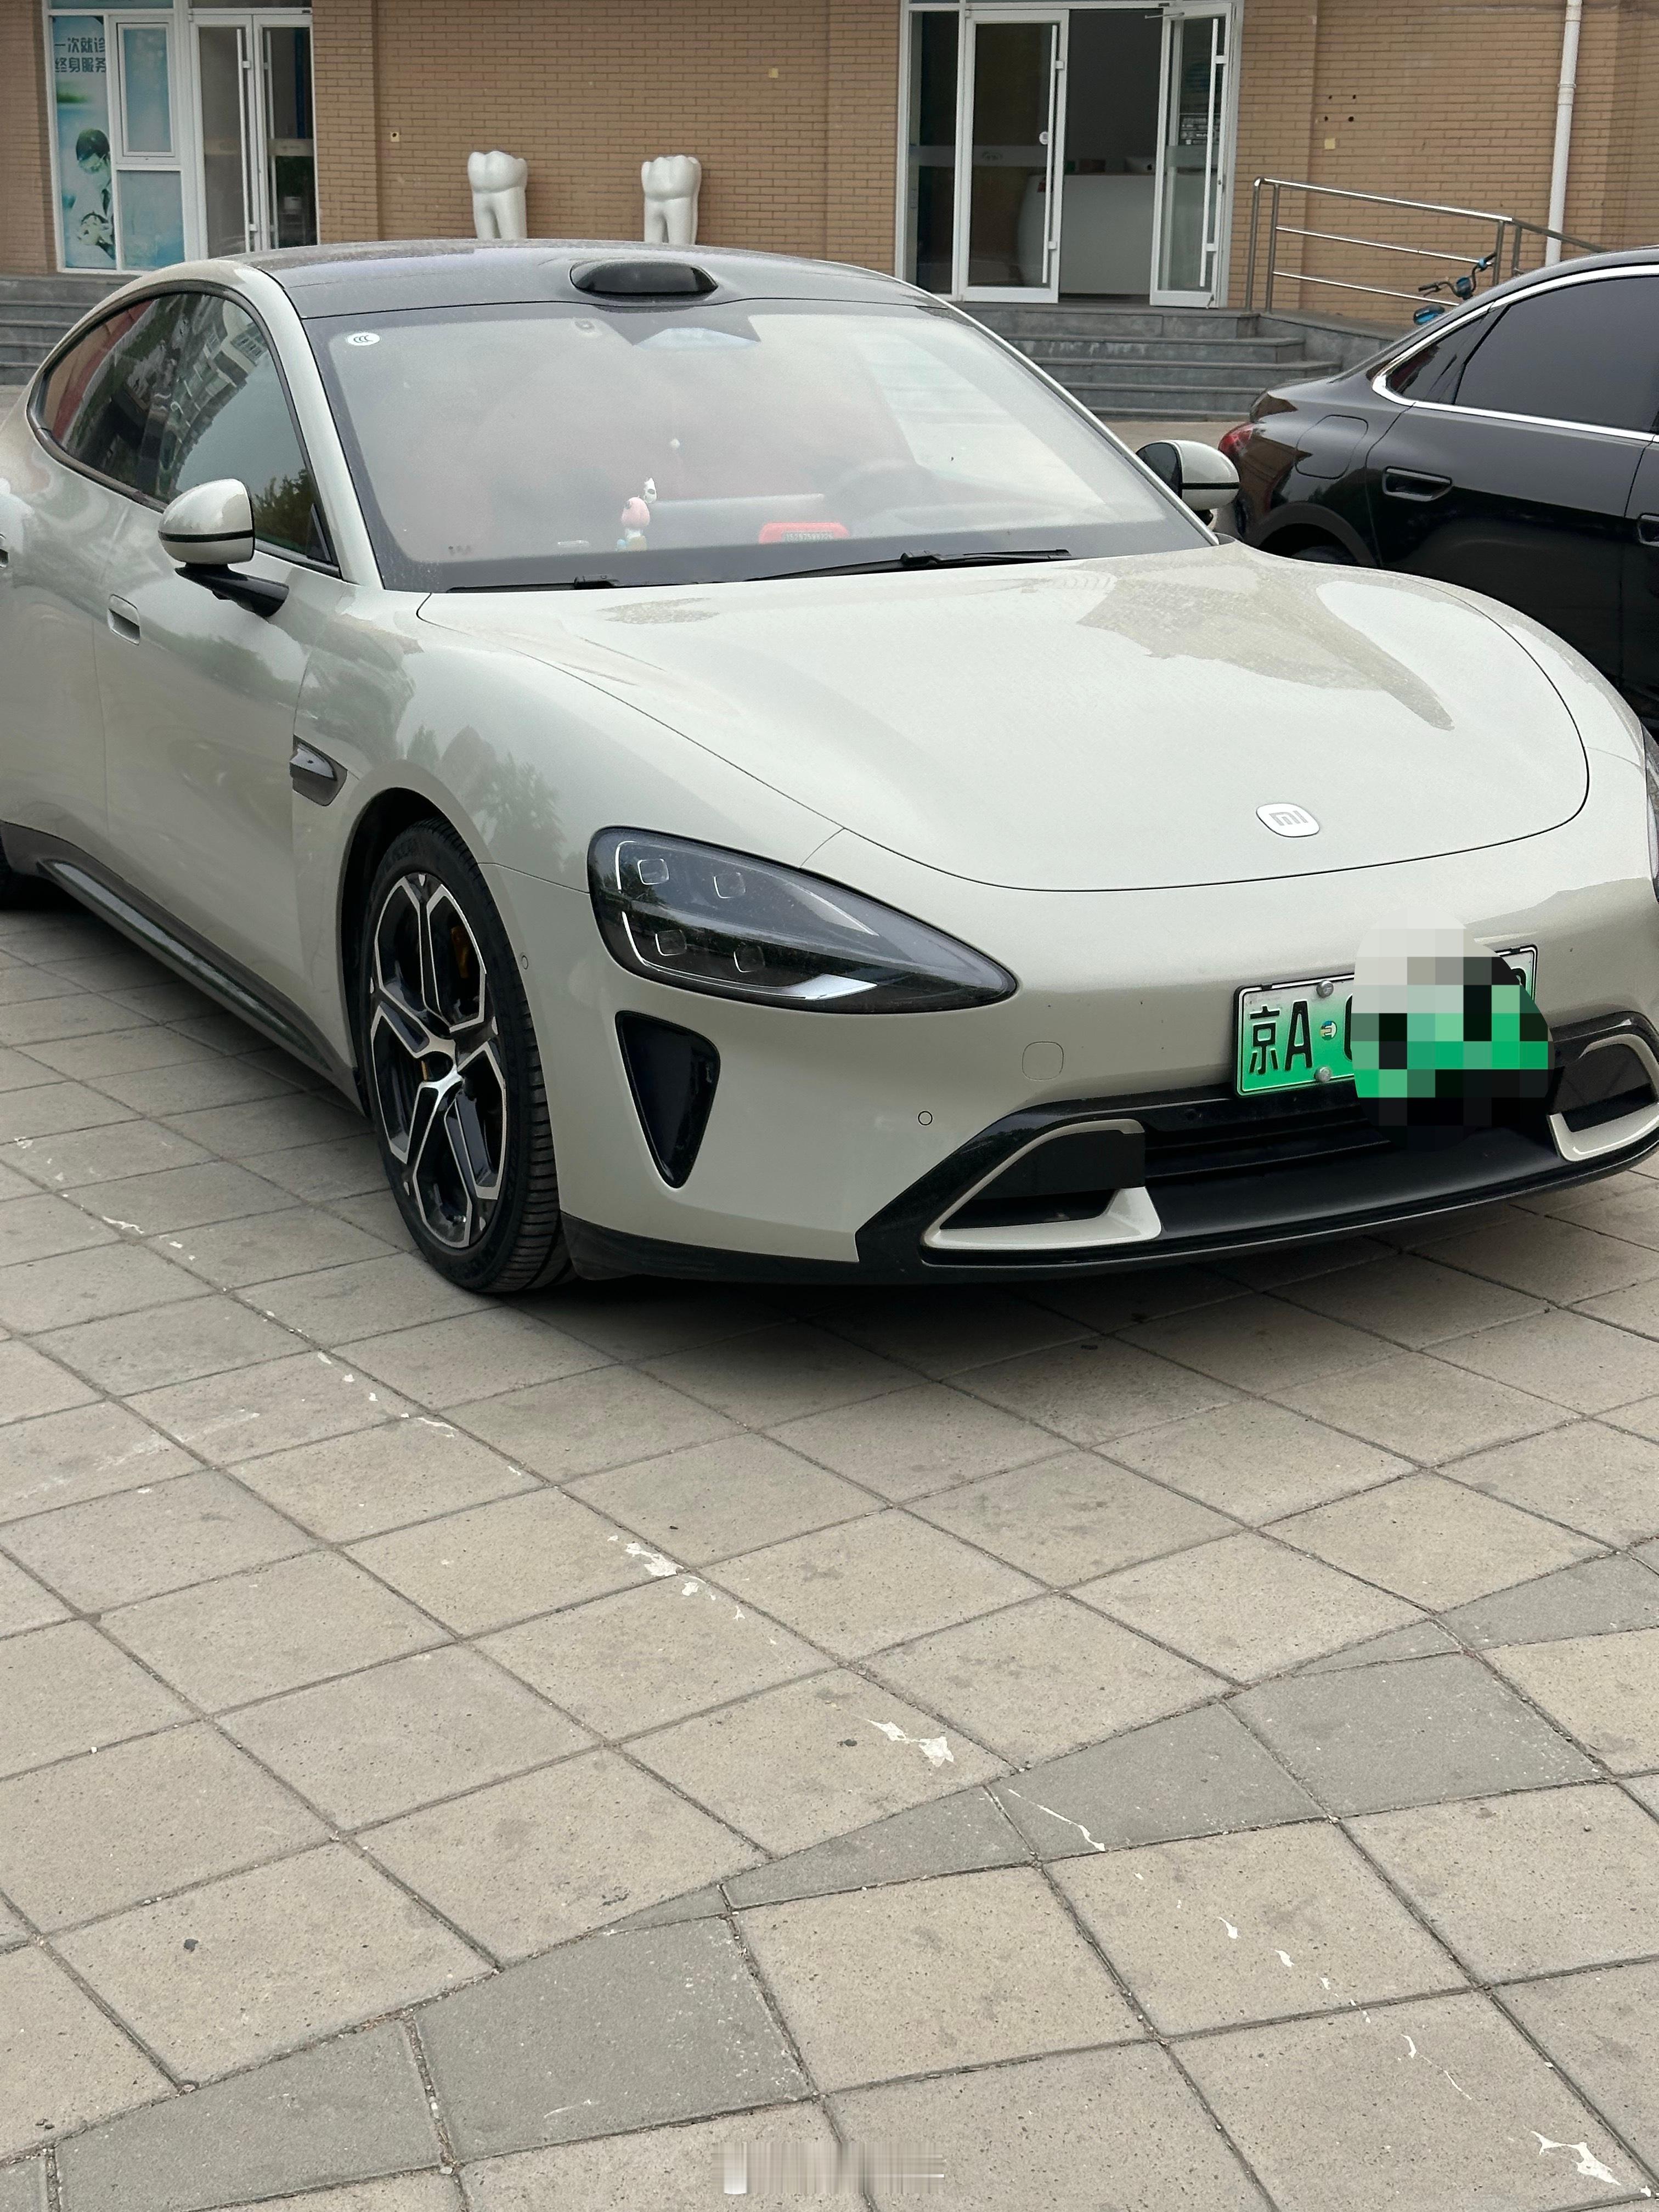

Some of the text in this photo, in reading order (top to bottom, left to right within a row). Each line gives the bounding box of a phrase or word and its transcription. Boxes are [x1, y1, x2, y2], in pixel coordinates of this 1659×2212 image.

[54, 37, 105, 53] 一次就诊
[55, 57, 106, 72] 终身服务
